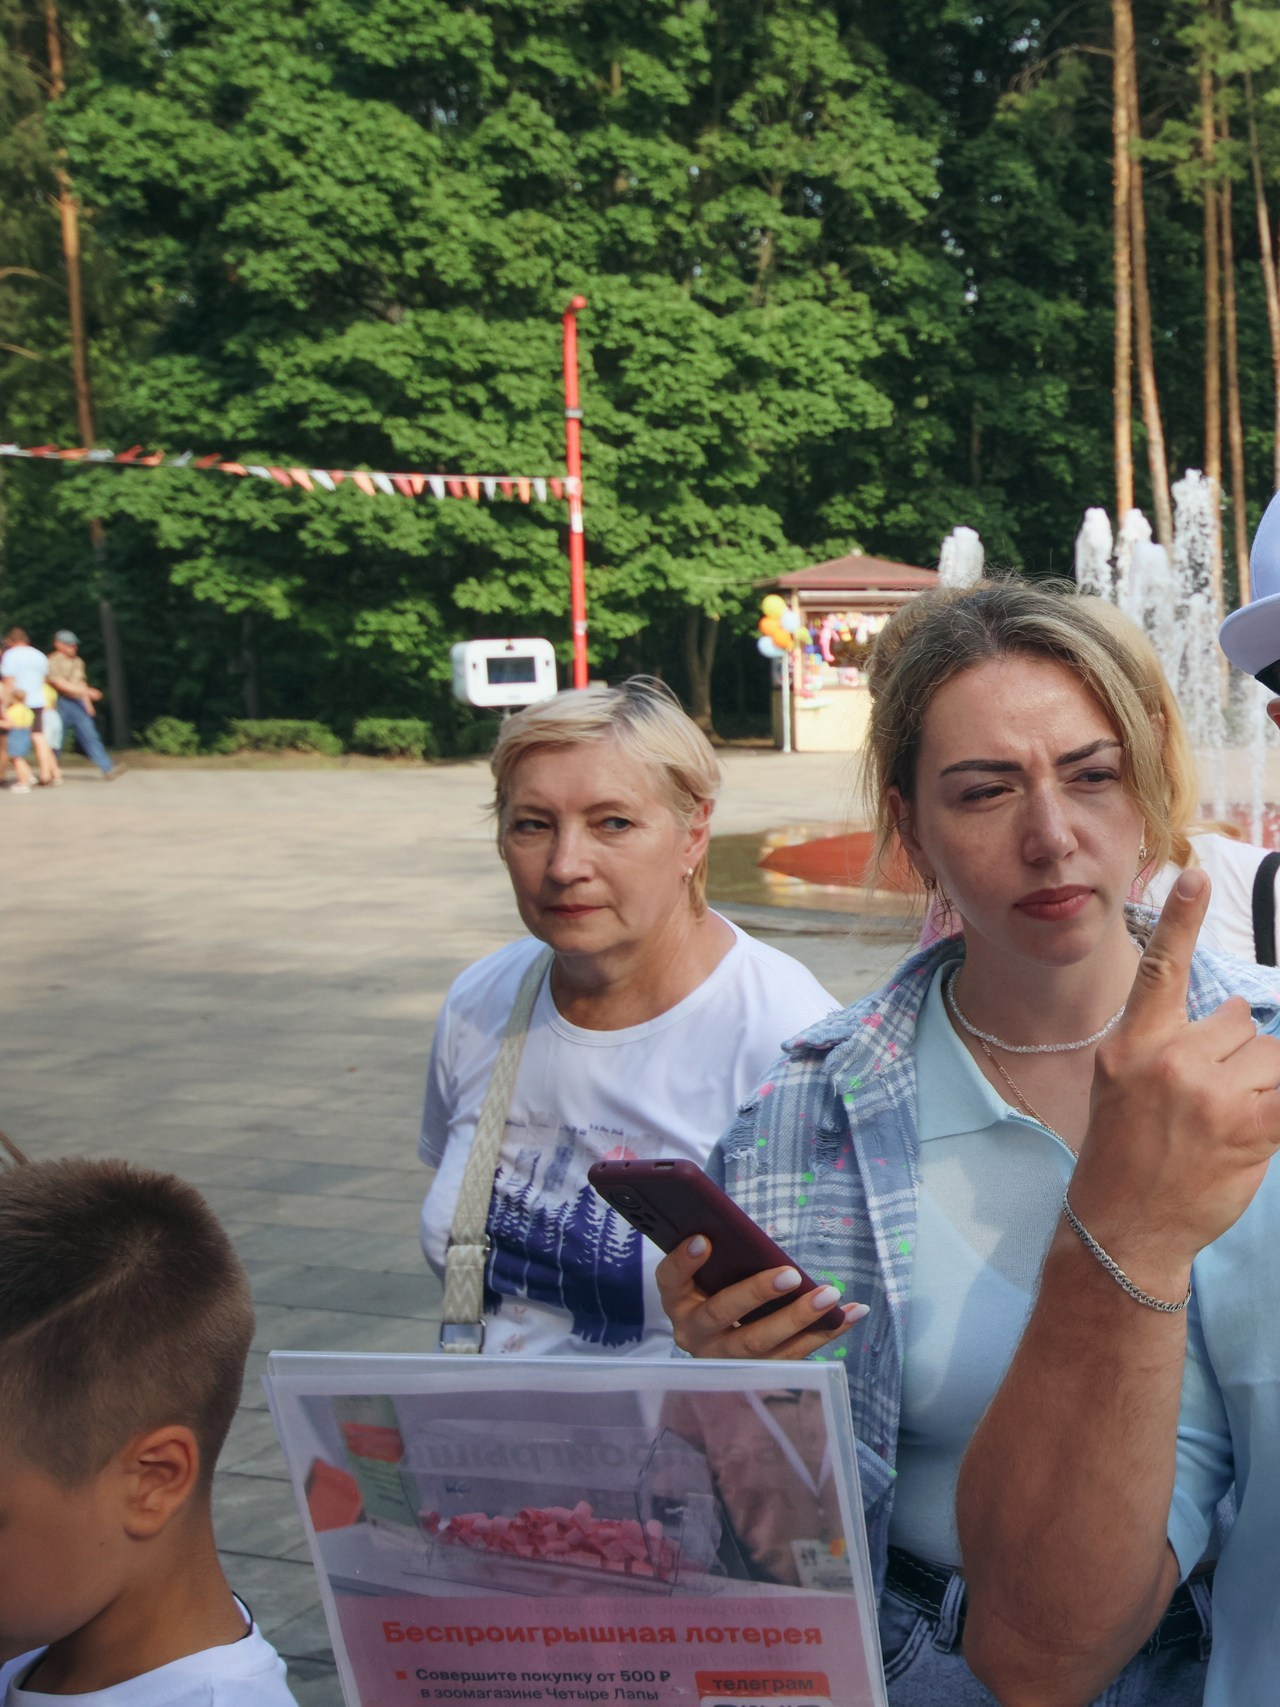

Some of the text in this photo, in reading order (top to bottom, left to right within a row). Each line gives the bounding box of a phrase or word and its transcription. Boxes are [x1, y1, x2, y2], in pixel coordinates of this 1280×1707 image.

[382, 1621, 823, 1648] Беспроигрышная лотерея
[415, 1668, 517, 1683] Совершите
[521, 1671, 592, 1684] покупку
[597, 1672, 616, 1682] от
[620, 1670, 655, 1682] 500
[712, 1678, 813, 1691] телеграм
[421, 1688, 659, 1701] в зоомагазине Четыре Лапы
